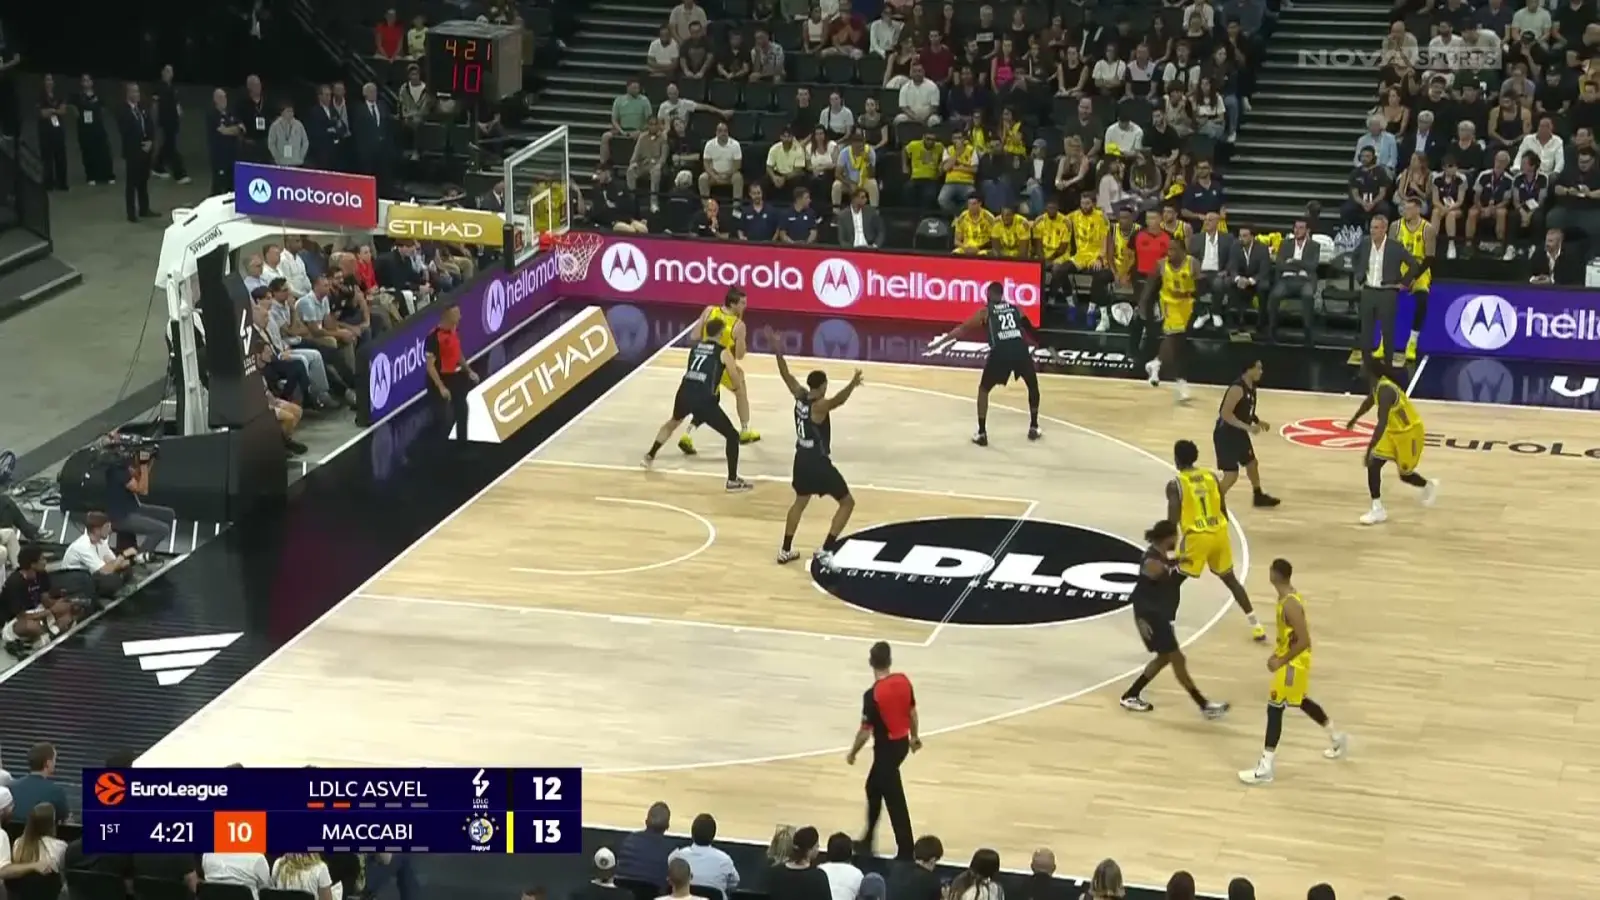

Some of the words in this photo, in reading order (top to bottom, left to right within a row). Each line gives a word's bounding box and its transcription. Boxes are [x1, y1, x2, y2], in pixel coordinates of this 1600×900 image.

[453, 63, 480, 92] 10
[277, 186, 362, 208] motorola
[388, 219, 482, 238] ETIHAD
[655, 256, 803, 291] motorola
[998, 312, 1016, 330] 28
[1526, 306, 1600, 341] hell
[493, 324, 609, 423] ETIHAD
[690, 354, 708, 371] 77
[832, 539, 1140, 594] LDLC
